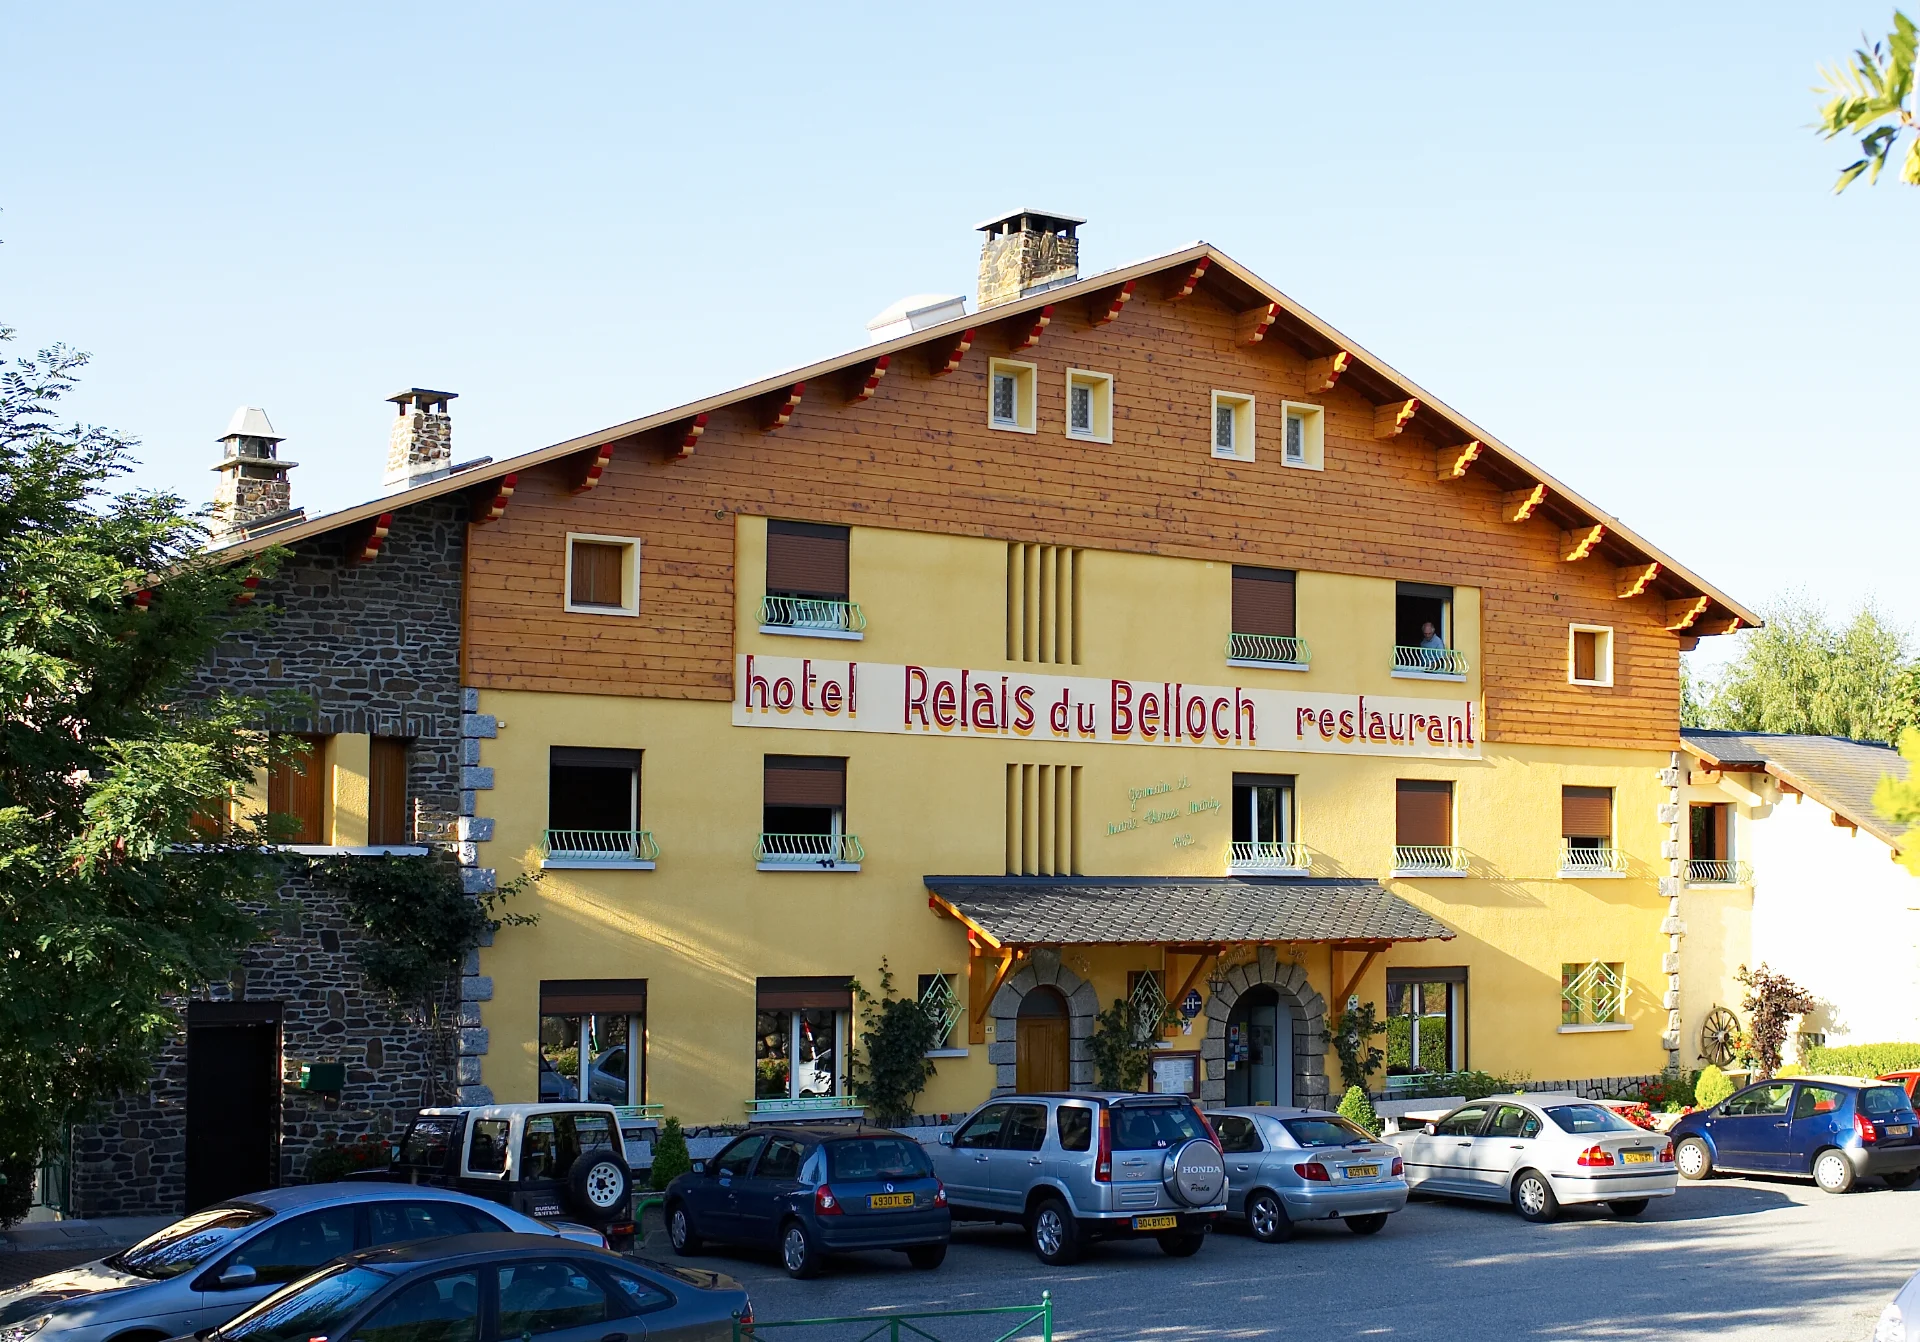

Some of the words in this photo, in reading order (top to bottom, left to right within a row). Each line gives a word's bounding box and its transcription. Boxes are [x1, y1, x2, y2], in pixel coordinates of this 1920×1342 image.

[745, 655, 857, 718] hotel
[905, 665, 1035, 737] Relais
[1050, 688, 1096, 739] du
[1111, 679, 1256, 746] Belloch
[1296, 696, 1476, 748] restaurant
[1182, 1166, 1221, 1174] HONDA
[873, 1195, 893, 1206] 4930
